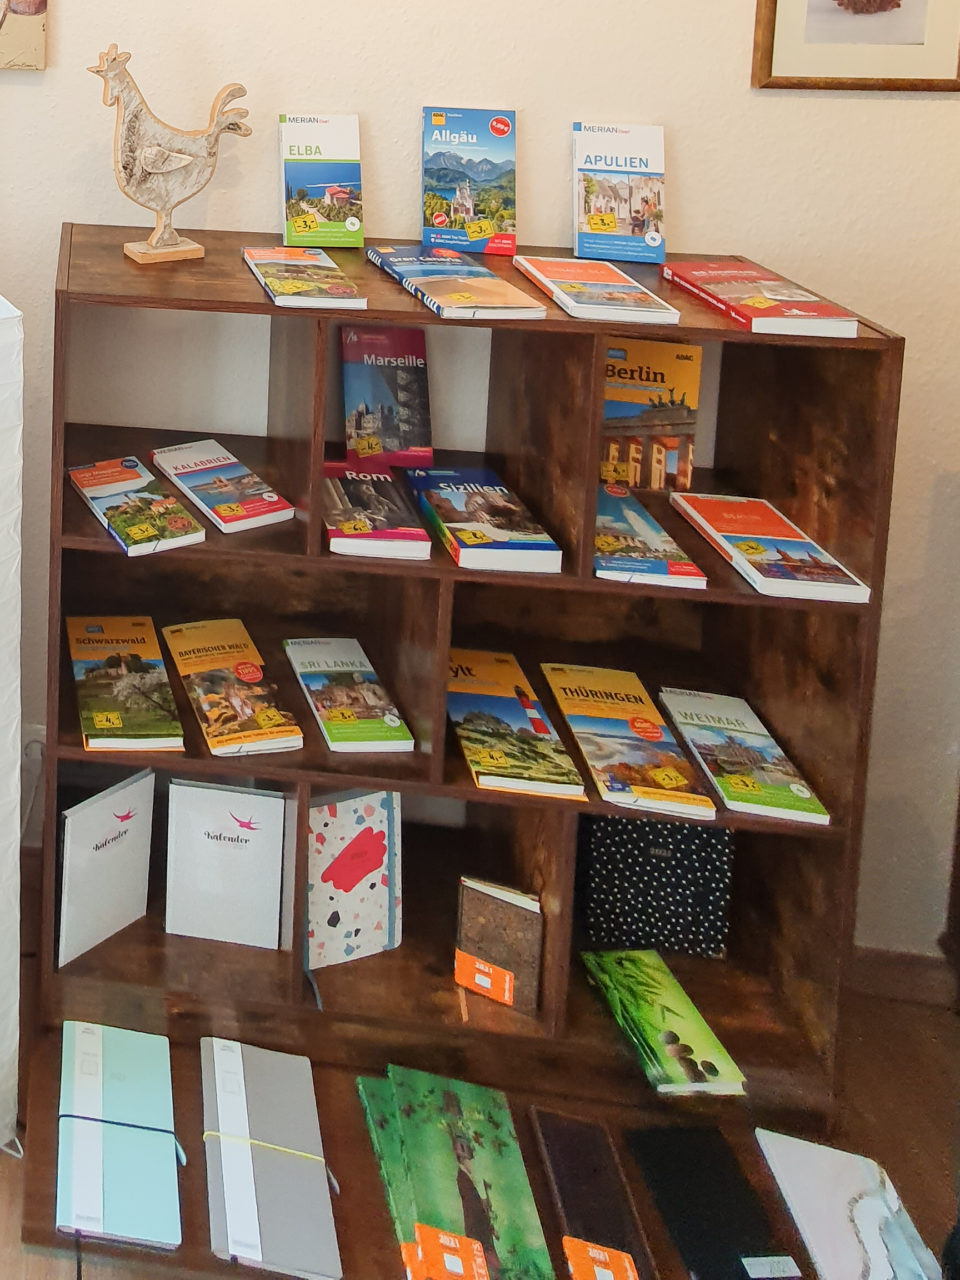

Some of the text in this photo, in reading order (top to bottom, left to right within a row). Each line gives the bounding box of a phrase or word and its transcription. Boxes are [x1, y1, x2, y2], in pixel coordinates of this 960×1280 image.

[288, 116, 319, 124] MERIAN
[431, 129, 478, 145] Allgäu
[583, 125, 618, 134] MERIAN
[289, 145, 322, 156] ELBA
[583, 154, 649, 169] APULIEN
[363, 353, 425, 368] Marseille
[605, 363, 667, 384] Berlin
[172, 455, 232, 472] KALABRIEN
[345, 470, 392, 482] Rom
[439, 482, 509, 494] Sizilien
[75, 636, 147, 646] Schwarzwald
[178, 642, 250, 658] BAYERISCHER WALD
[299, 660, 323, 670] SRI
[559, 685, 645, 706] THÜRINGEN
[677, 709, 748, 729] WEIMAR
[92, 827, 129, 853] Kalender
[203, 830, 251, 845] Kalender
